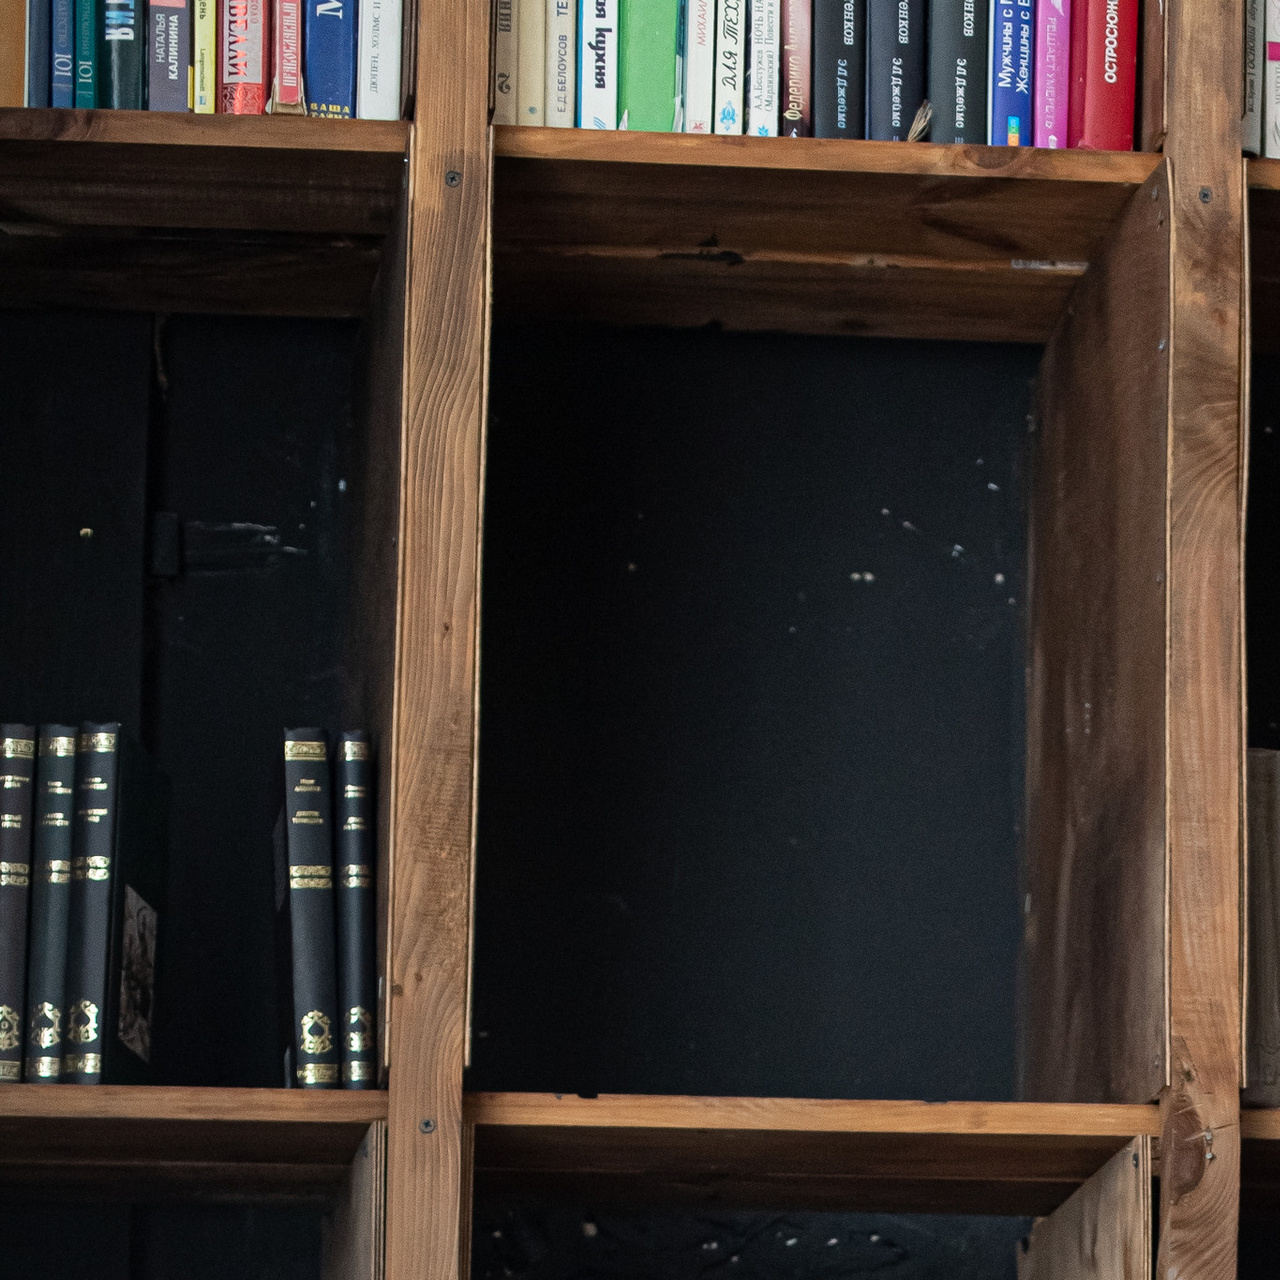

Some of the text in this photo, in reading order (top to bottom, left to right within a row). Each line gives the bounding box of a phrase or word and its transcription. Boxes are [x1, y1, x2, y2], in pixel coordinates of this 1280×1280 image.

[155, 13, 167, 63] НАТАЛЬЯ
[168, 14, 180, 80] КАЛИНИНА
[369, 12, 381, 51] ХОЛМС
[753, 16, 765, 45] НОЧЬ
[998, 22, 1016, 88] Мужчины
[1246, 26, 1257, 70] ОСНОВЫ
[56, 52, 73, 76] 101
[78, 59, 94, 84] 101
[199, 48, 208, 92] Langenscheidt
[587, 28, 613, 89] кухня
[721, 50, 738, 91] ДЛЯ
[764, 14, 776, 112] (Марлинский) Повести
[1015, 23, 1031, 94] Женщины
[310, 102, 350, 113] ВАША
[836, 77, 848, 129] Джеймс
[890, 75, 903, 128] Джеймс
[954, 76, 968, 129] Джеймс
